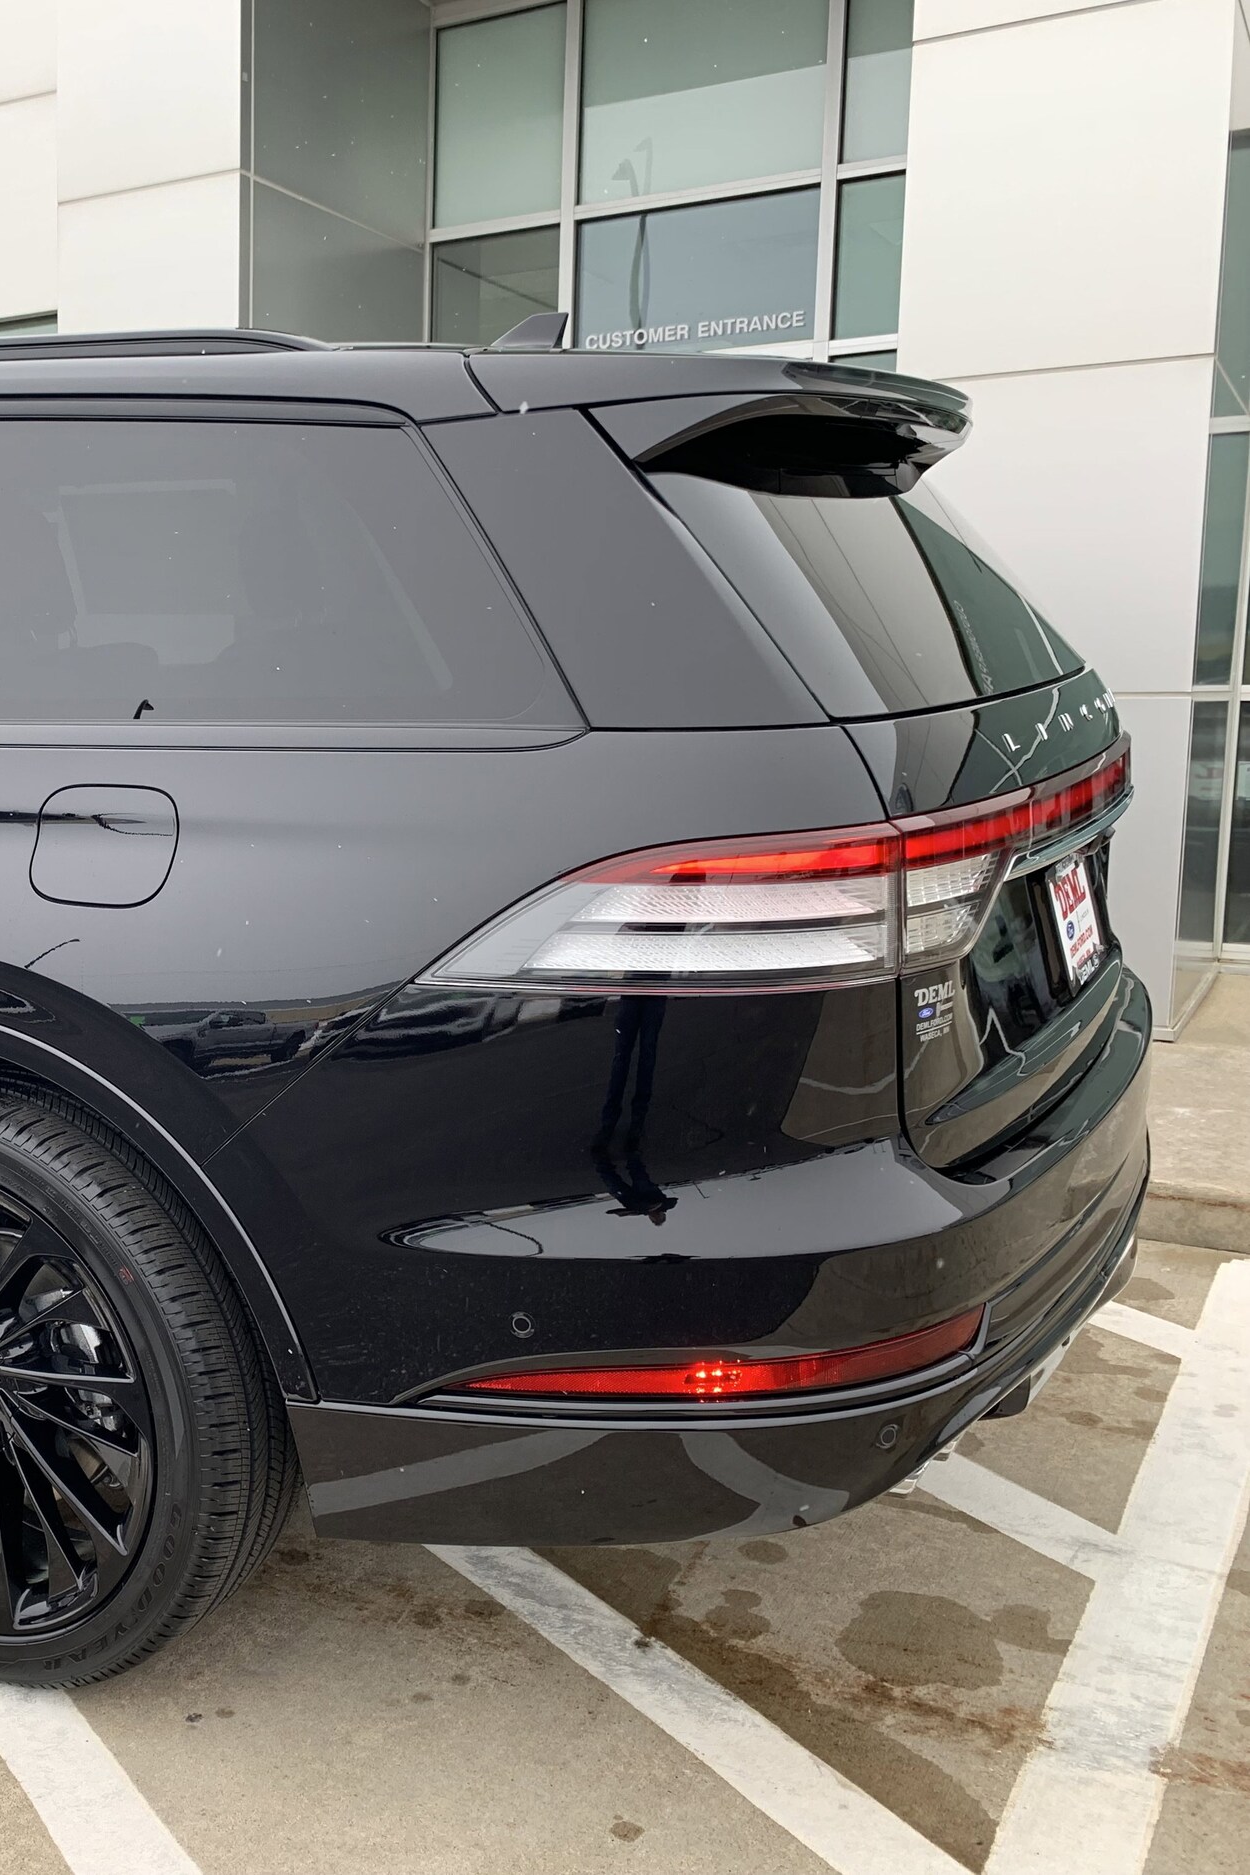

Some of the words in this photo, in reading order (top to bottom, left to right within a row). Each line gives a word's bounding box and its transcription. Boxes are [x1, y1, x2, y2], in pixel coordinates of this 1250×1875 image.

[585, 324, 688, 350] CUSTOMER
[698, 311, 805, 338] ENTRANCE
[1054, 868, 1086, 920] DEML
[914, 981, 956, 1007] DEML
[43, 1502, 182, 1671] GOODYEAR
